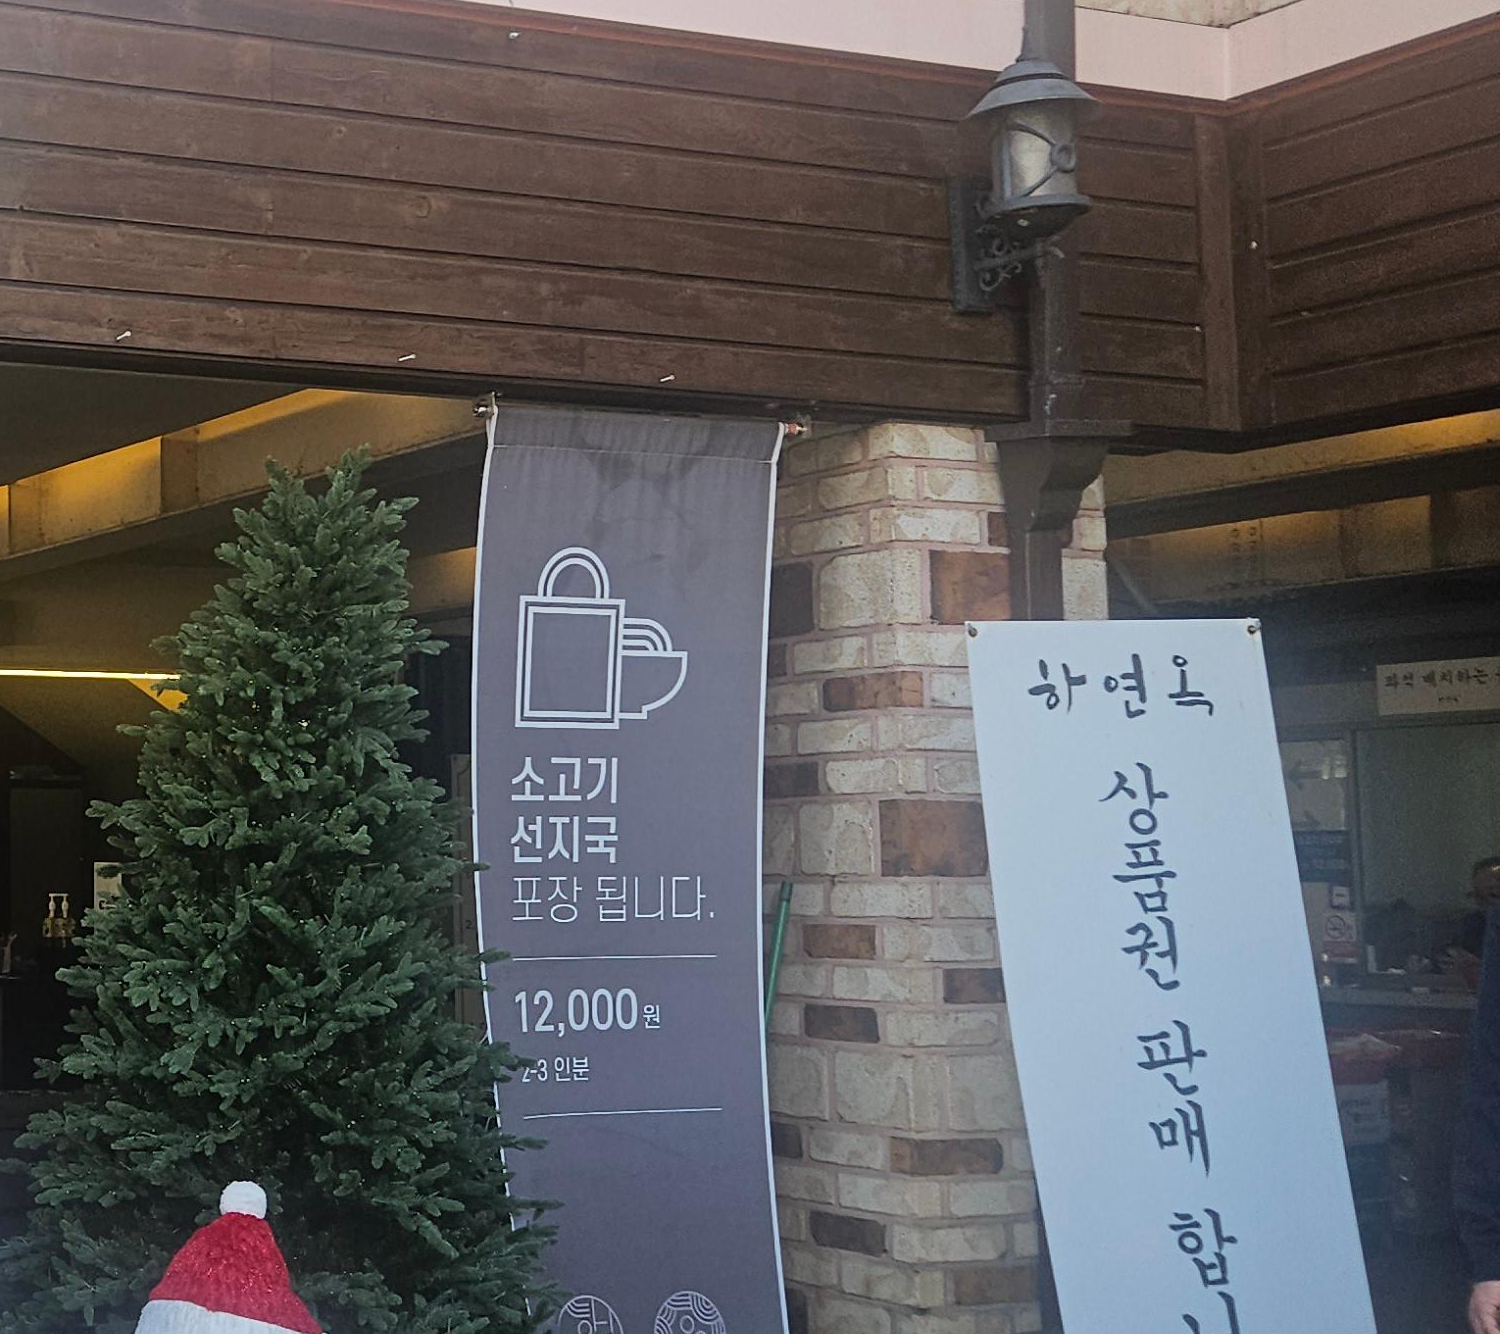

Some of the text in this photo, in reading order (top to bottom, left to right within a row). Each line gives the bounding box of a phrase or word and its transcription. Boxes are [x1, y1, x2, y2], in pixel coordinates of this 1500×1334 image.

[1028, 653, 1214, 719] 하연옥
[511, 756, 619, 804] 소고기
[510, 815, 619, 864] 선지국
[512, 875, 716, 923] 포장 됩니다.
[1099, 762, 1181, 992] 상품권
[554, 1056, 590, 1082] 인분
[1136, 1019, 1211, 1177] 판매
